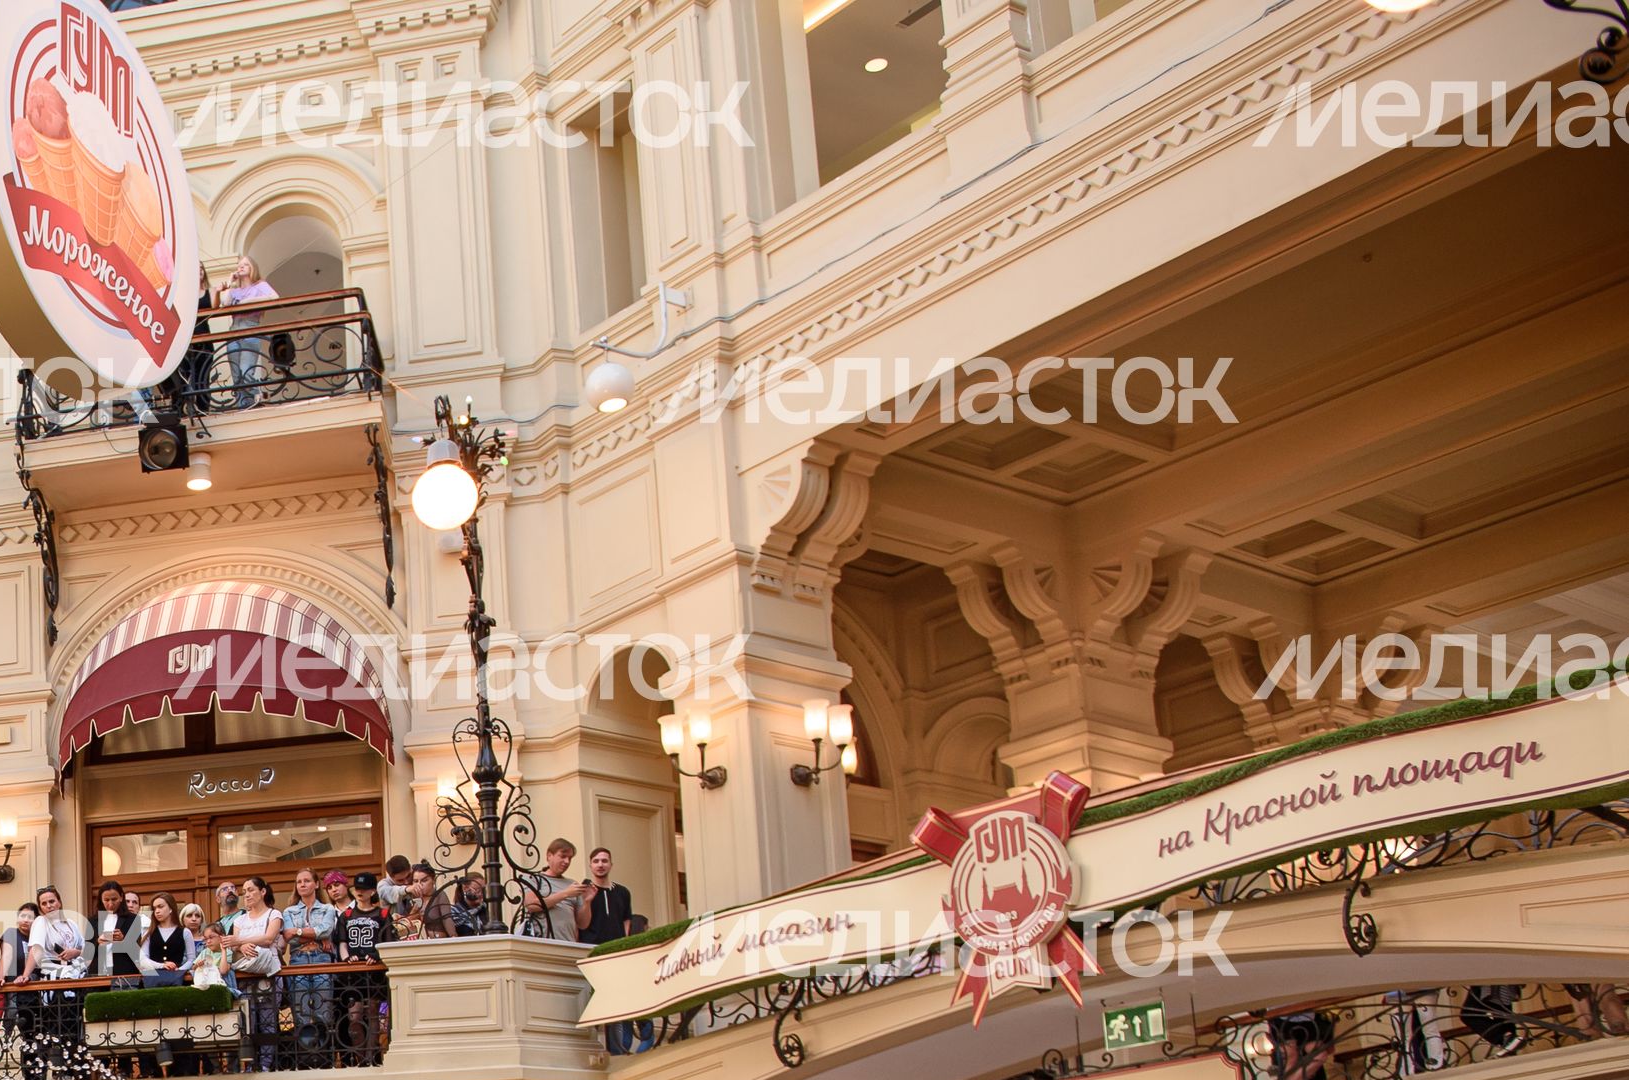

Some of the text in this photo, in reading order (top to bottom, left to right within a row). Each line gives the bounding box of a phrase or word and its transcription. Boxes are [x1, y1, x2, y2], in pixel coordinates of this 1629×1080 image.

[60, 2, 134, 139] ГУМ
[22, 204, 166, 344] Мороженое
[168, 643, 214, 674] ГУМ
[1157, 740, 1543, 858] на Красной площади
[974, 816, 1027, 864] ГУМ
[348, 926, 373, 948] 92
[654, 912, 856, 985] Главный магазин
[994, 955, 1035, 981] GUM
